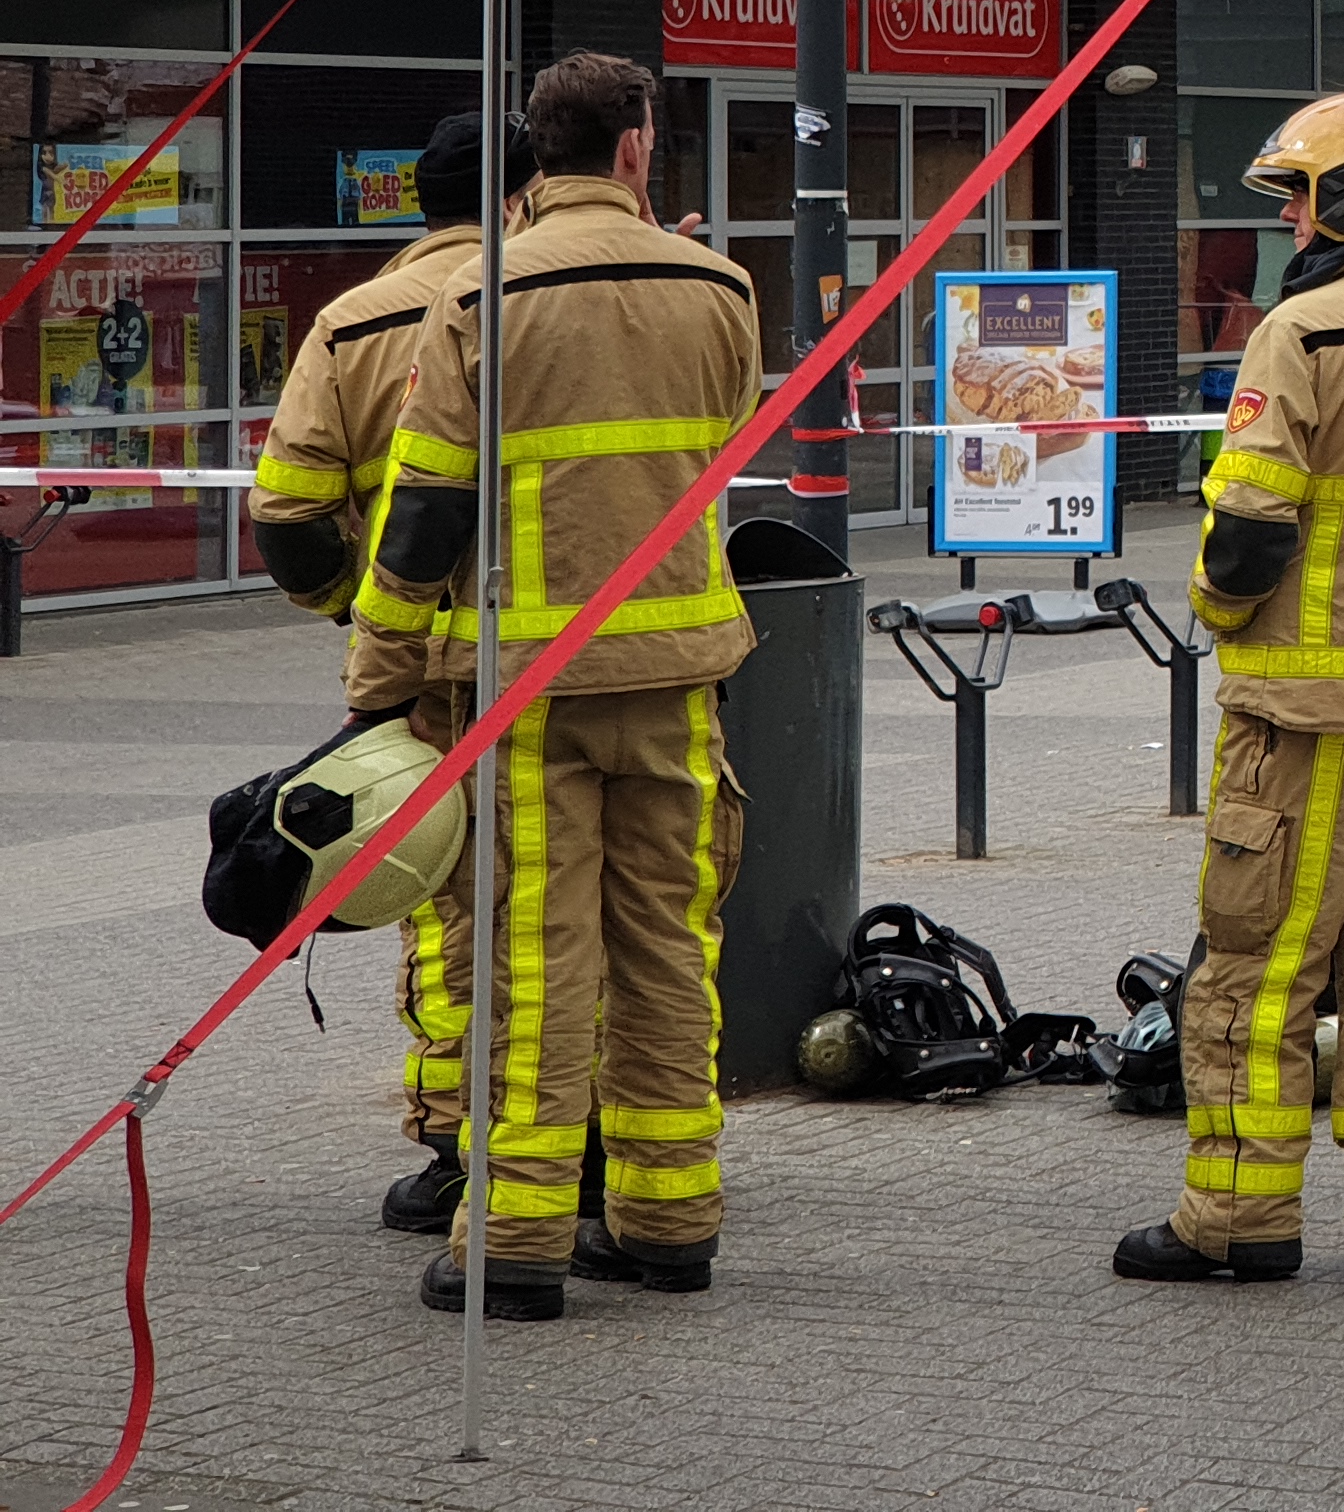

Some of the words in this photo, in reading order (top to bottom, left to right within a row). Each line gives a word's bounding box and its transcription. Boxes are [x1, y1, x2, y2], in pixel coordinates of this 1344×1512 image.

[362, 194, 400, 212] KOPER
[50, 268, 145, 308] ACTIE!
[240, 265, 280, 303] IE!
[103, 316, 142, 350] 2+2
[986, 315, 1061, 331] EXCELLENT
[1047, 496, 1094, 536] 1.99
